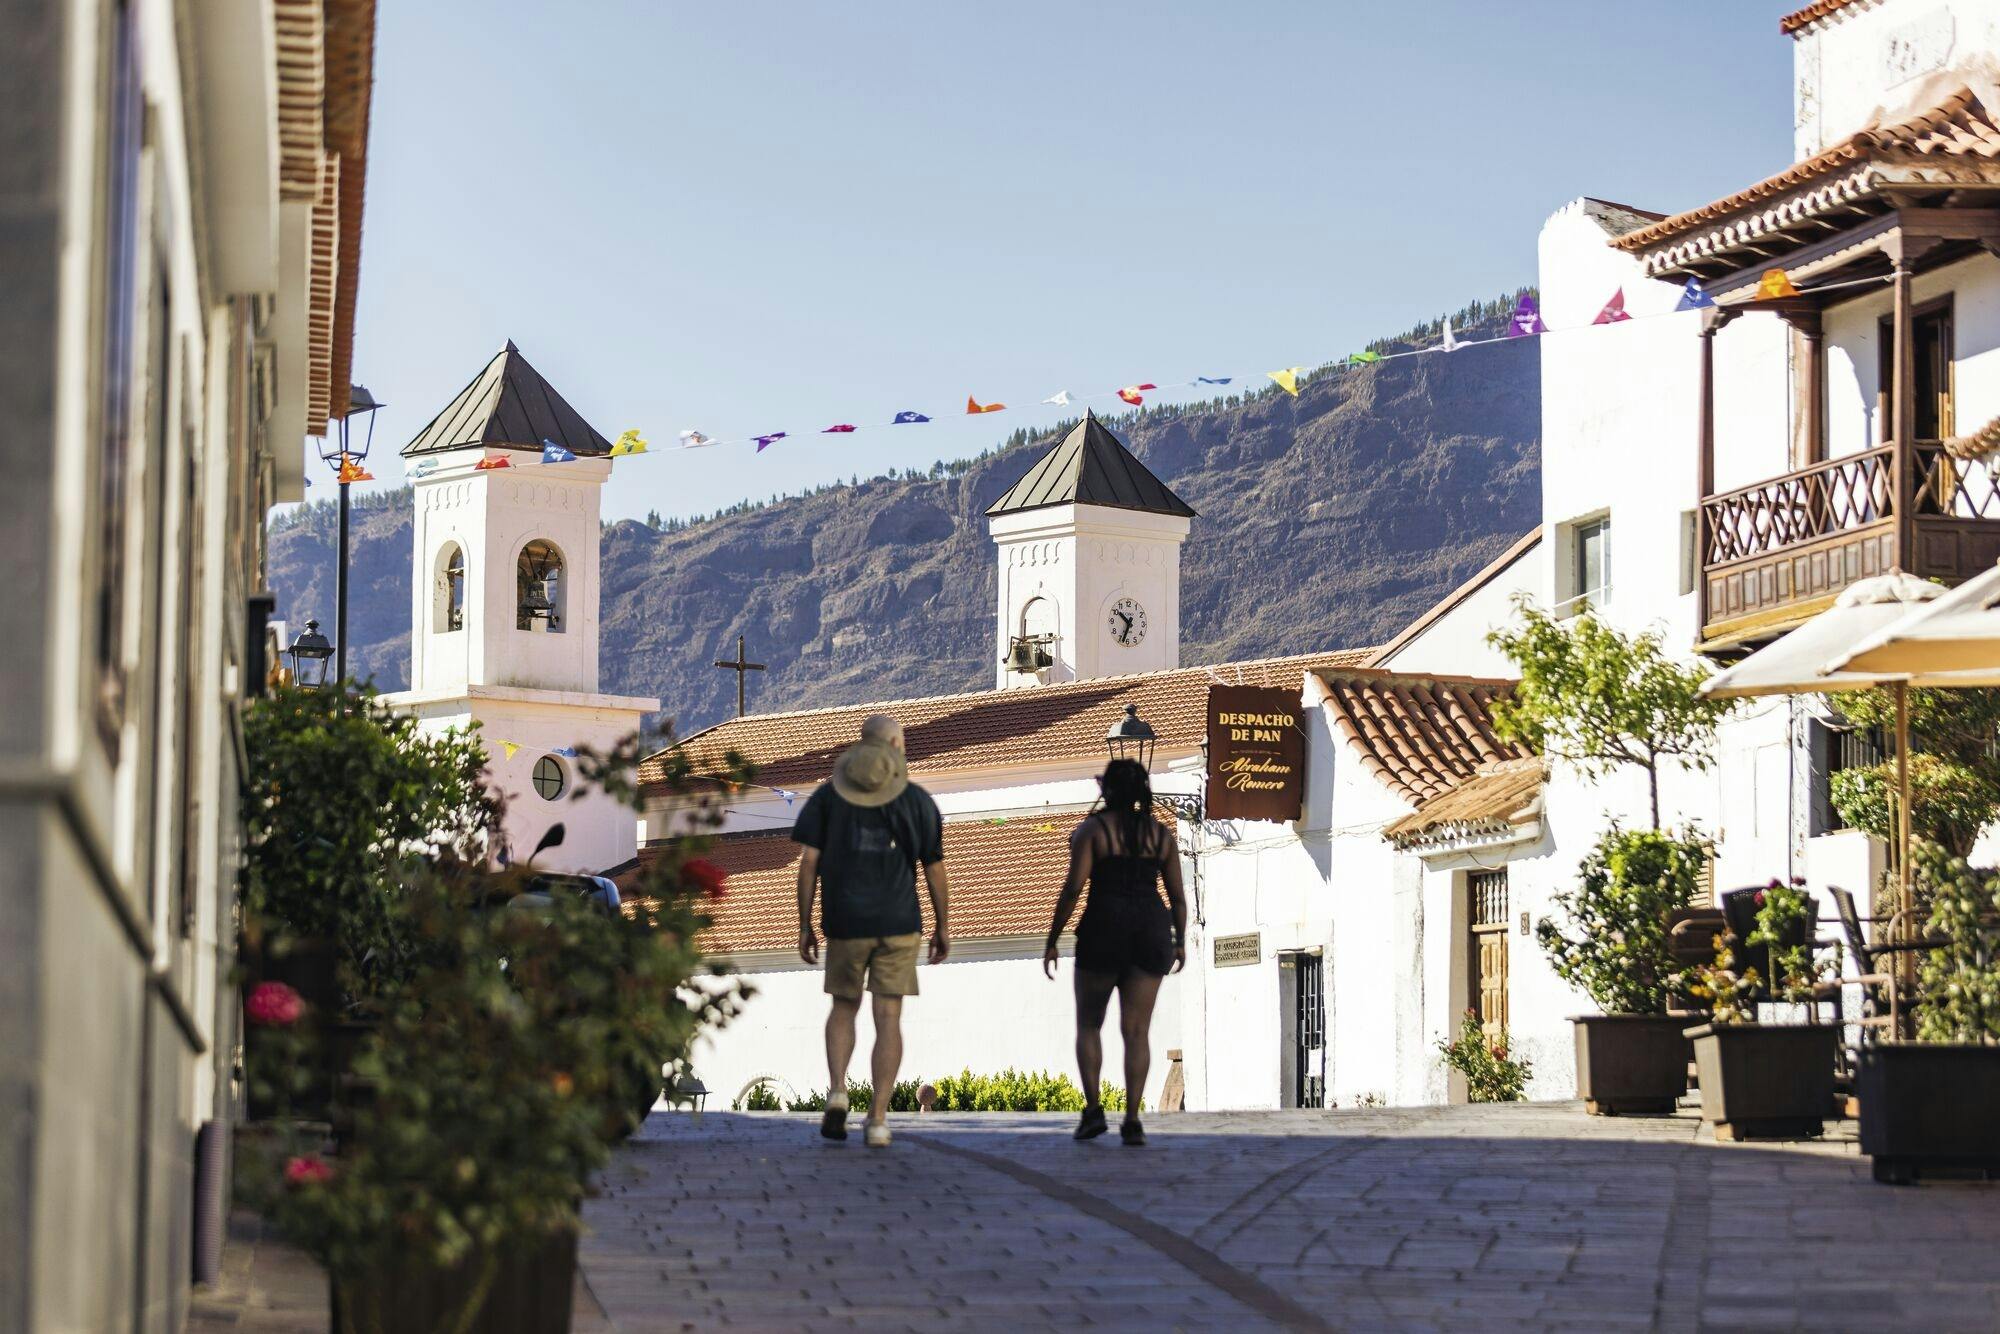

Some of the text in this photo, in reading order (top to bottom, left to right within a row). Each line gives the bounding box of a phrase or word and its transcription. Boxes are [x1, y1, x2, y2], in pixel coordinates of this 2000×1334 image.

[1219, 712, 1294, 727] DESPACHO
[1231, 728, 1281, 742] DE PAN
[1219, 757, 1292, 774] Abraham
[1226, 772, 1286, 792] Romero
